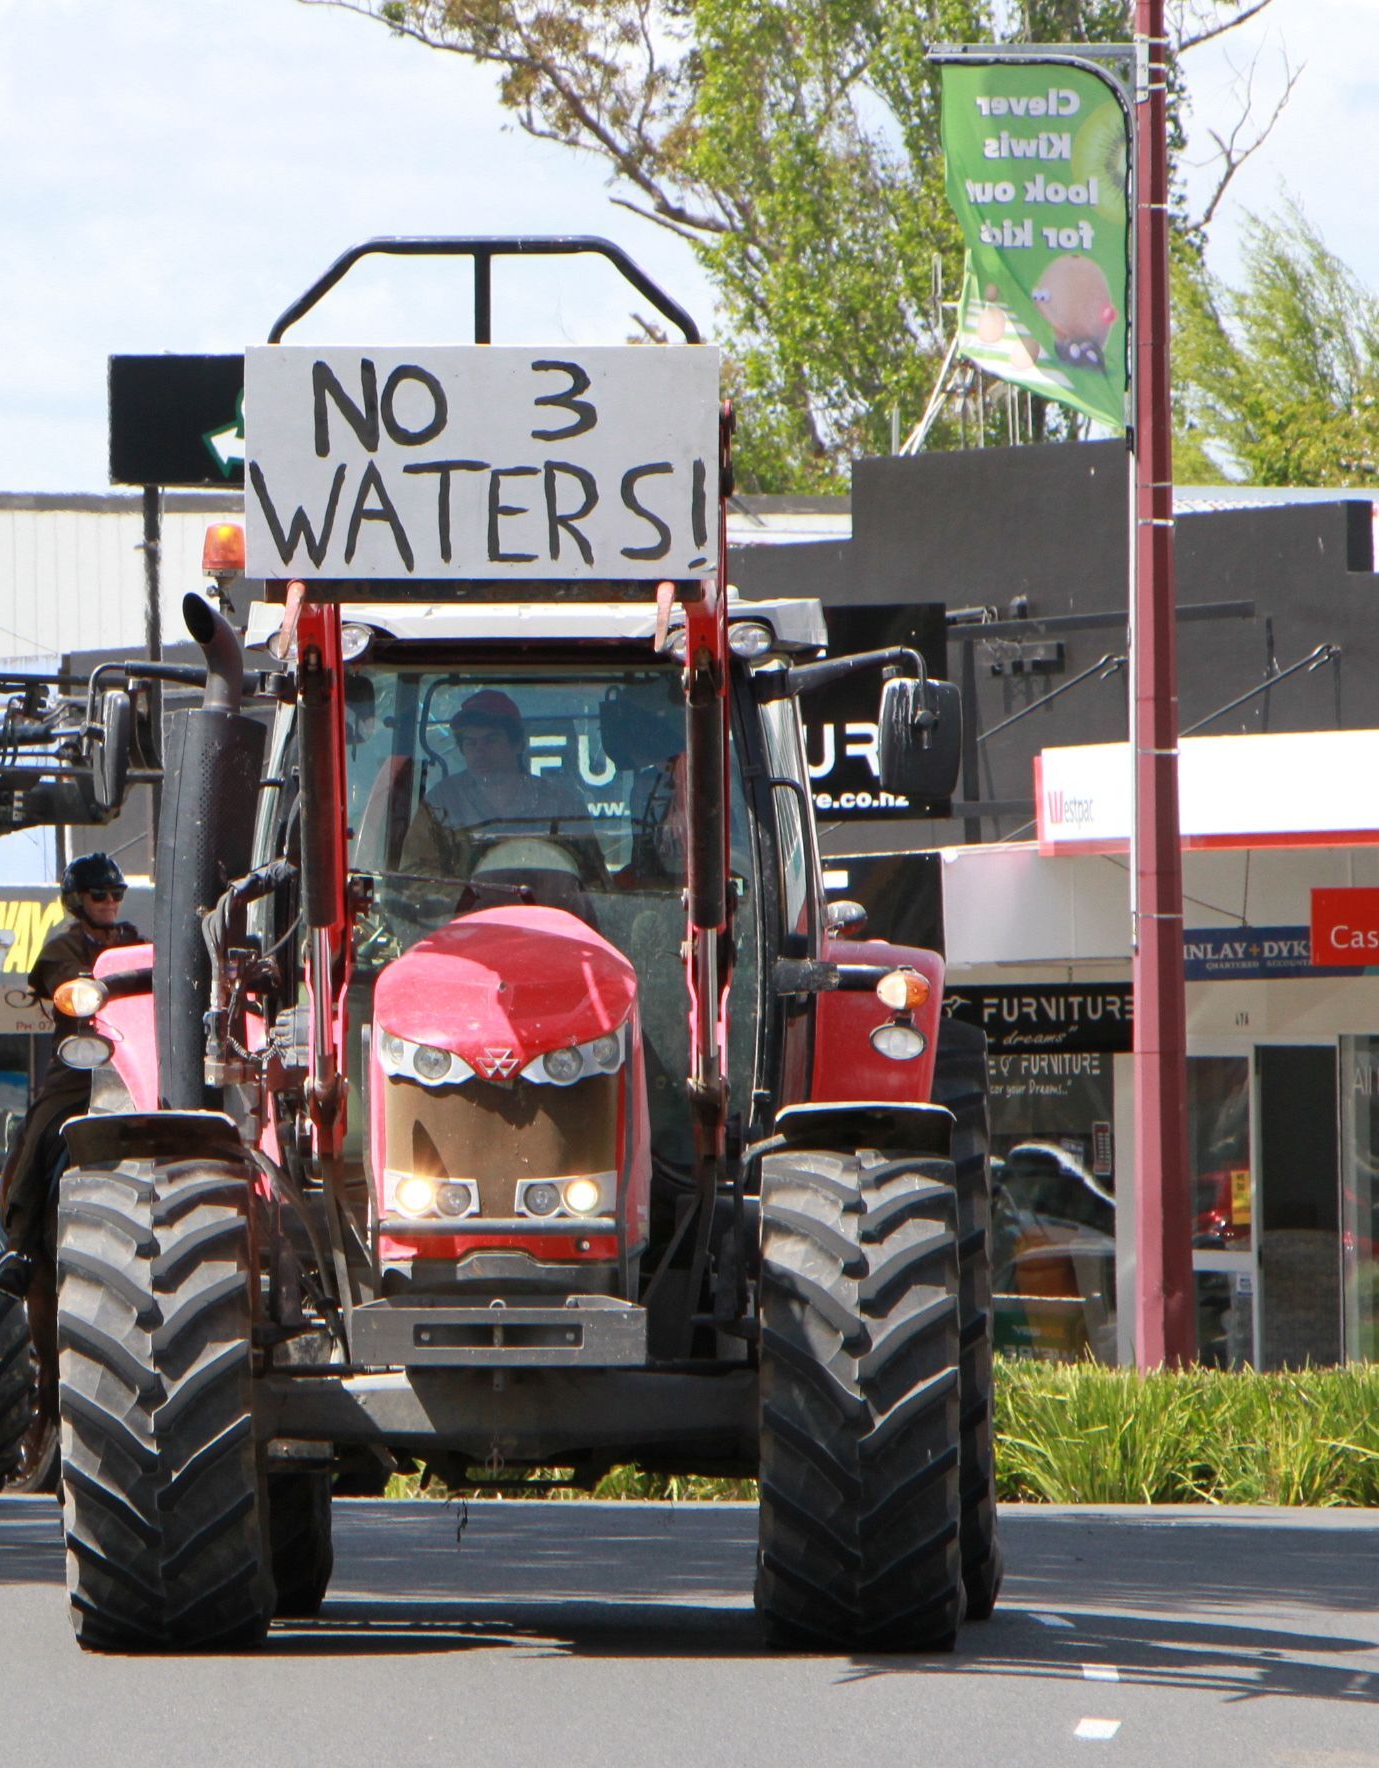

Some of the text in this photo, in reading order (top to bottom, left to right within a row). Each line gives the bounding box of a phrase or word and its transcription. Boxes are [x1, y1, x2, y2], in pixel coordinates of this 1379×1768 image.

[312, 357, 598, 457] NO 3
[249, 457, 709, 573] WATERS!
[1047, 790, 1094, 832] Westpac
[1262, 940, 1310, 958] DYK
[982, 996, 1134, 1023] FURNITURE
[1021, 1052, 1101, 1076] FURNITURE
